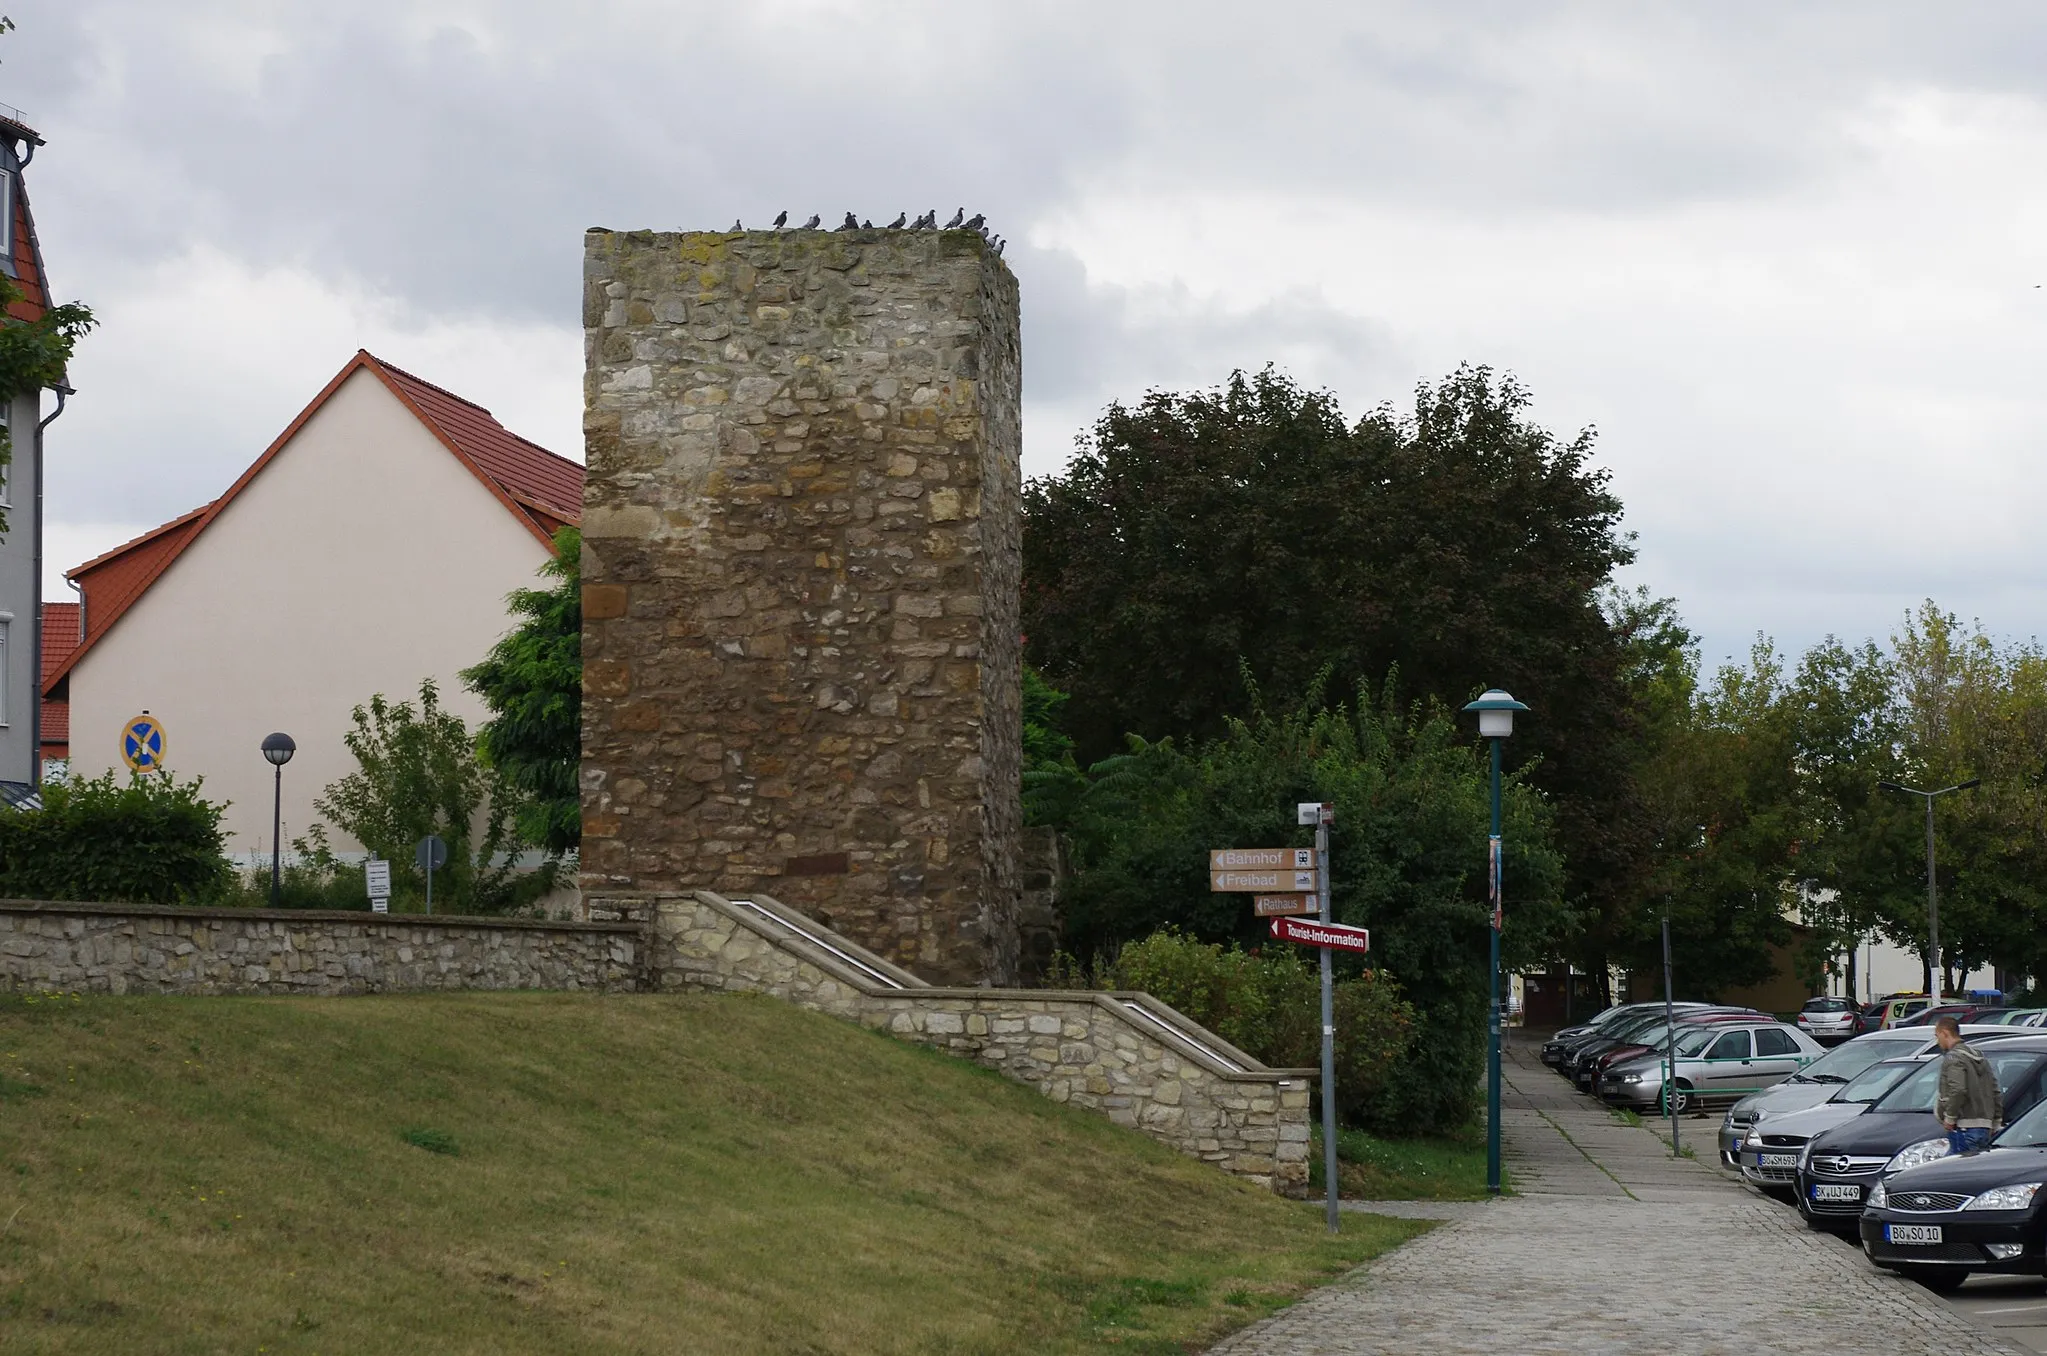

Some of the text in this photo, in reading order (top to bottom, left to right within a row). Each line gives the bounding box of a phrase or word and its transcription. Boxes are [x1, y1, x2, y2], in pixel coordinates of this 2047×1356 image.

[1226, 852, 1283, 865] Bahnhof
[1226, 873, 1277, 886] Freibad
[1263, 898, 1298, 910] Rathaus
[1287, 923, 1364, 948] Tourist-Information
